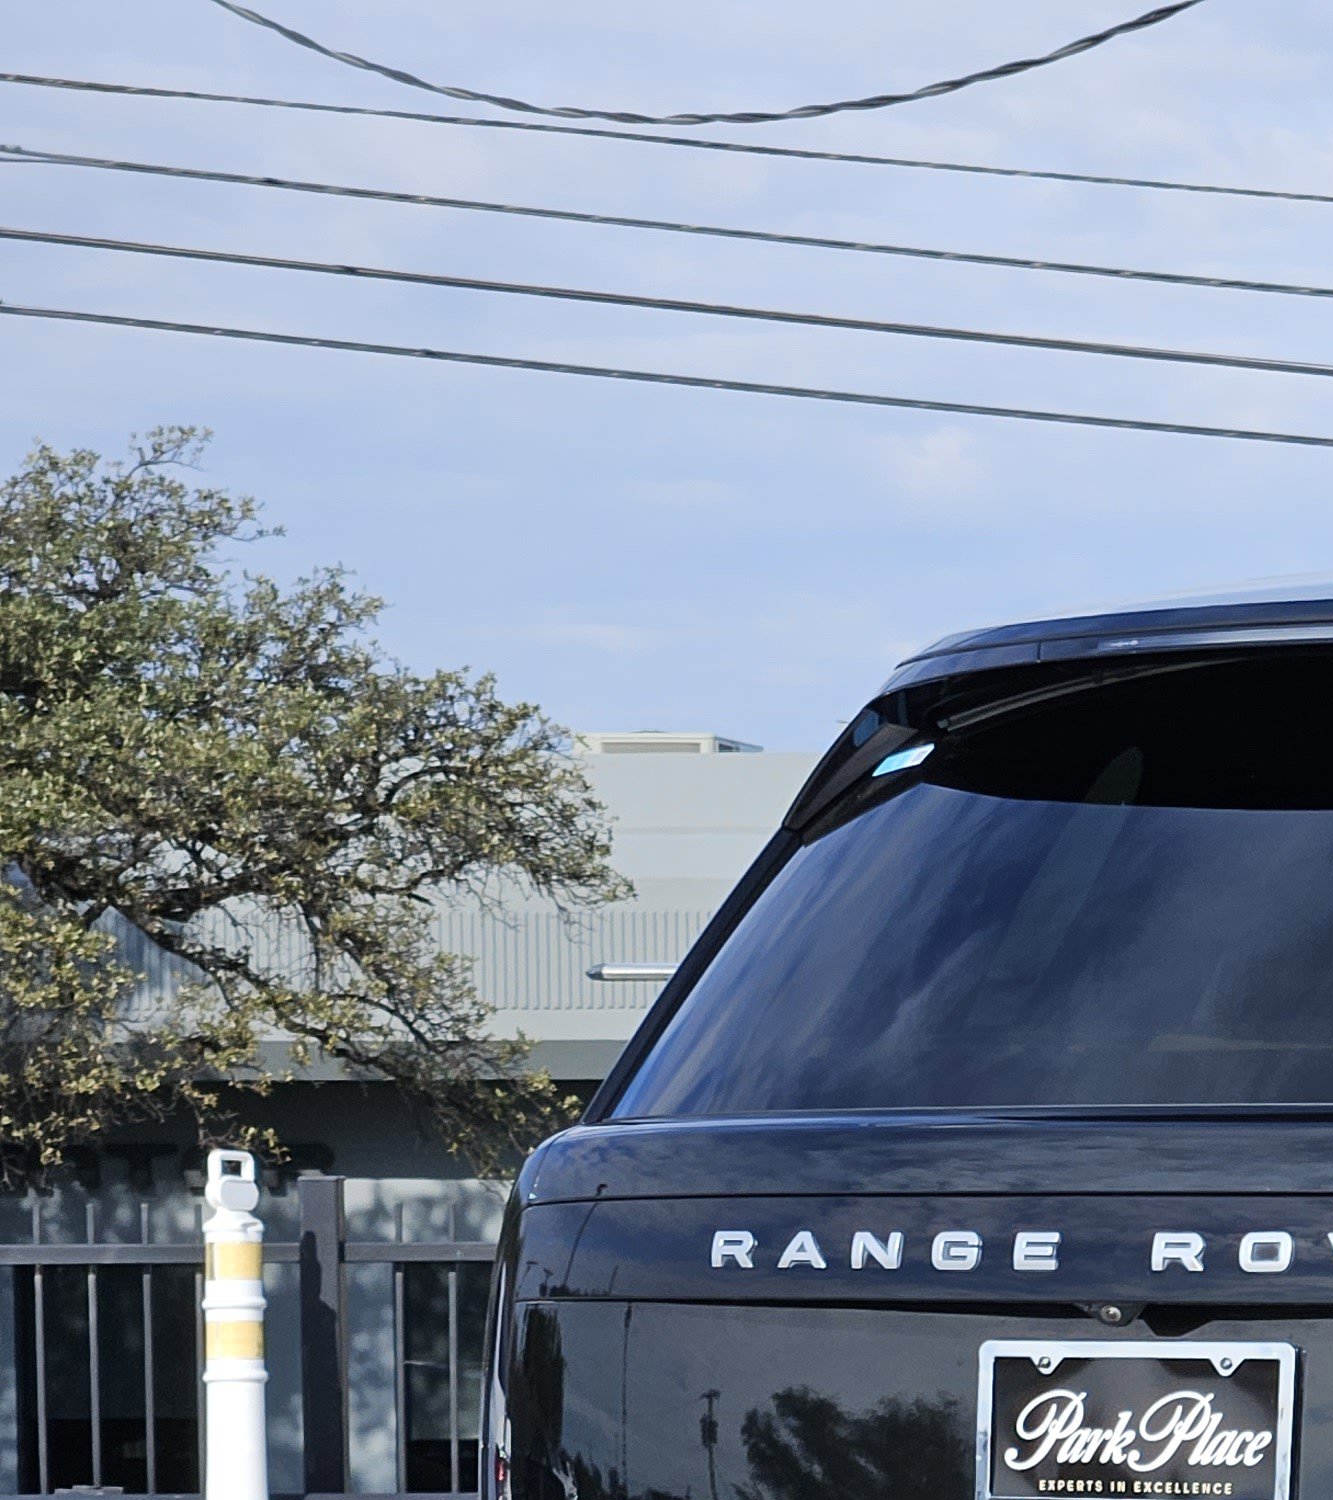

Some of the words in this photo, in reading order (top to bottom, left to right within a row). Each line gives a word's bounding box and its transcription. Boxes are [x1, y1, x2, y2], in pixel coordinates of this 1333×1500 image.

[709, 1229, 1061, 1271] RANGE
[1004, 1389, 1136, 1471] Park
[1127, 1390, 1273, 1473] Place
[1038, 1479, 1104, 1493] EXPERTS
[1110, 1480, 1127, 1493] IN
[1133, 1481, 1233, 1495] EXCELLENCE
